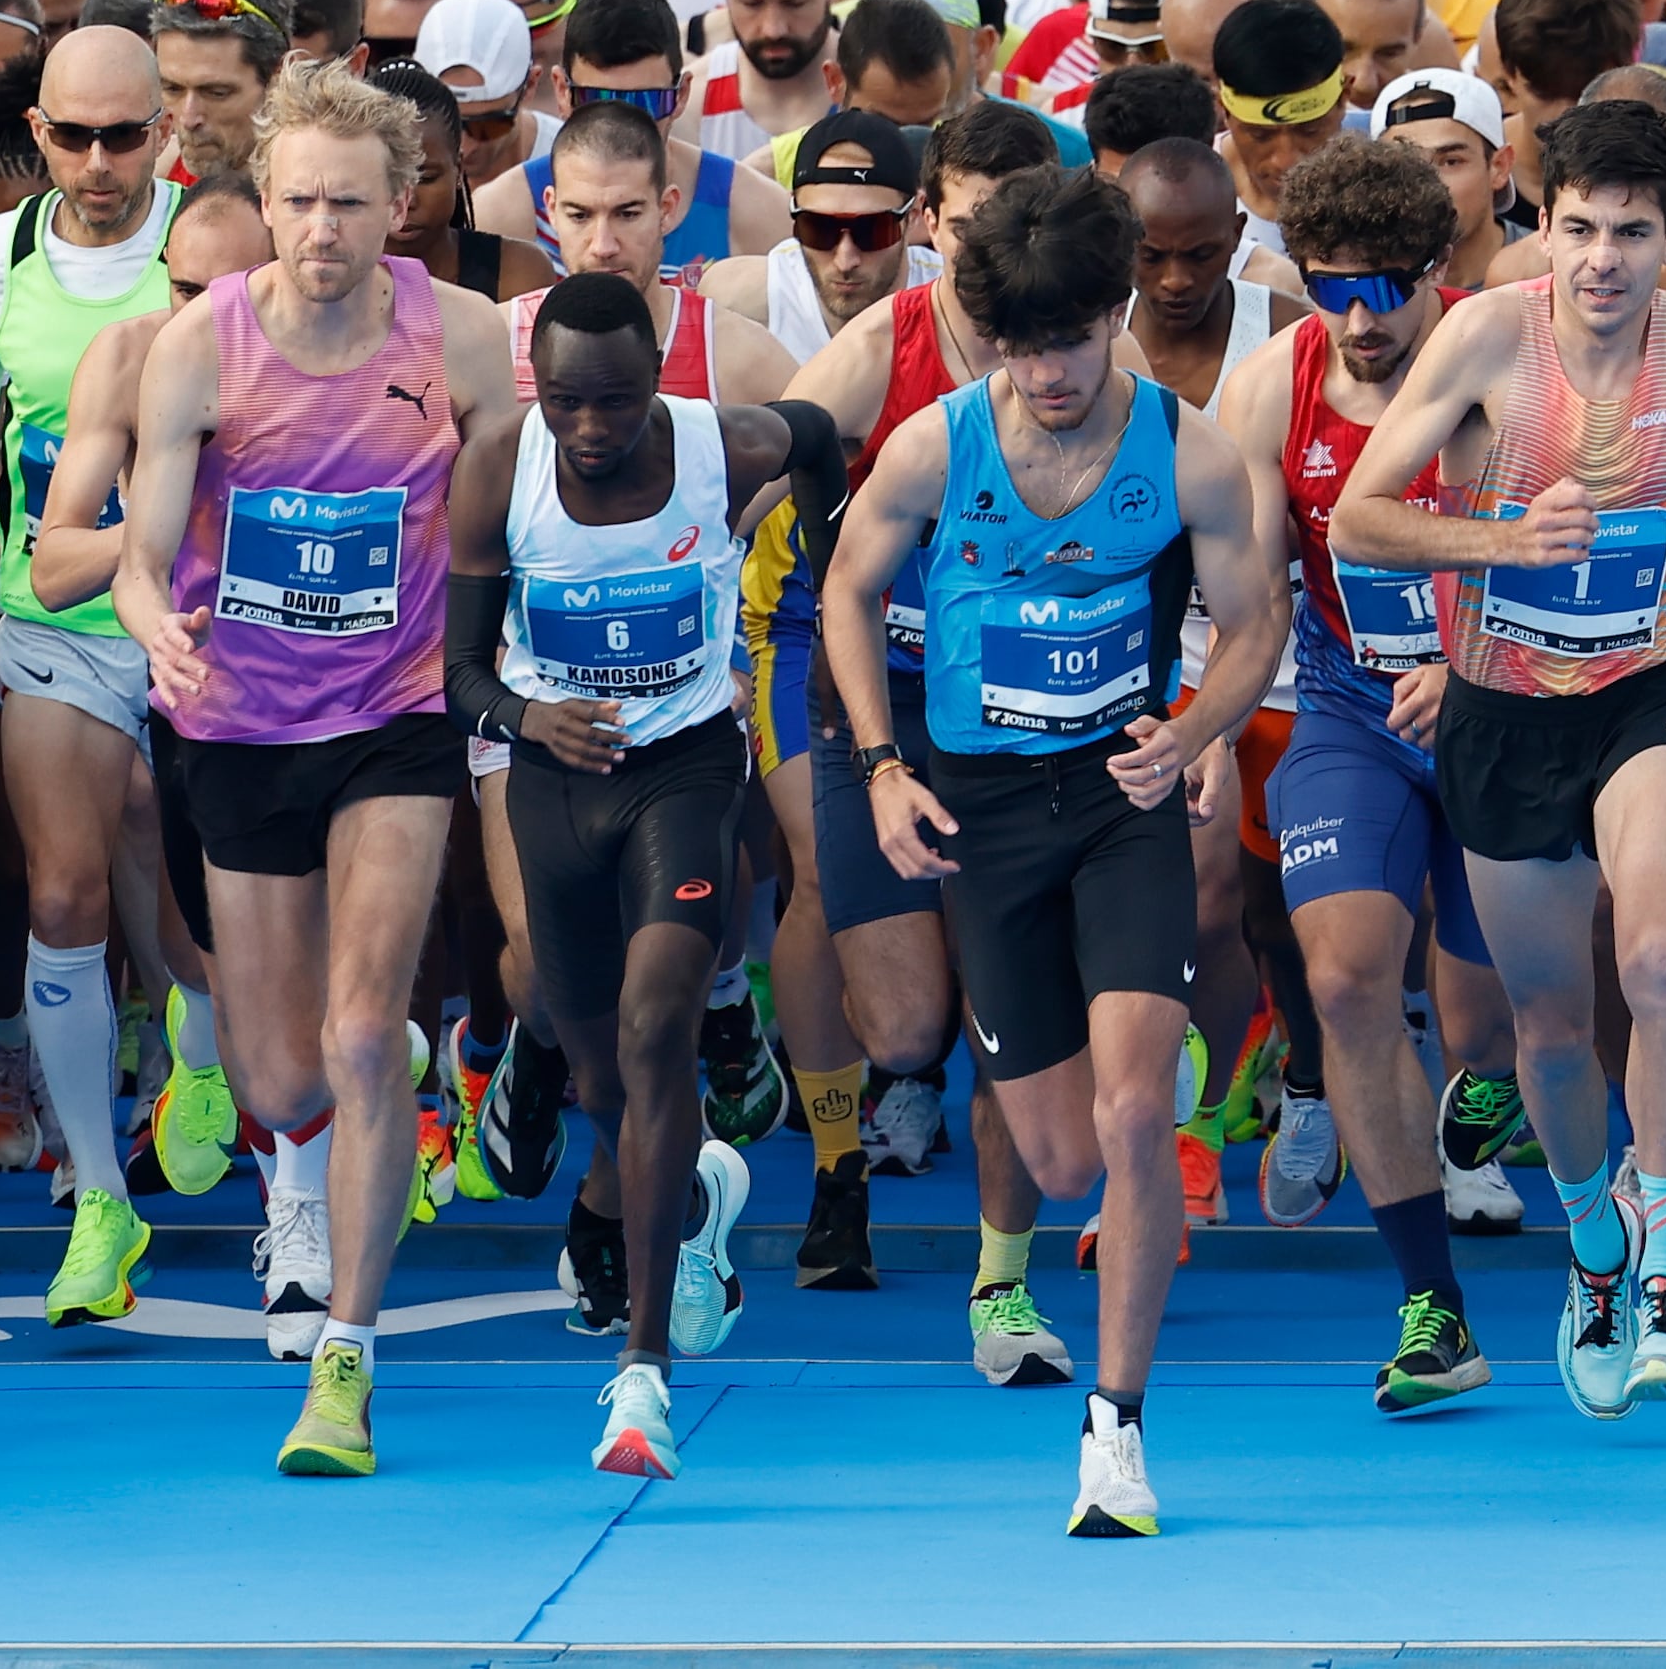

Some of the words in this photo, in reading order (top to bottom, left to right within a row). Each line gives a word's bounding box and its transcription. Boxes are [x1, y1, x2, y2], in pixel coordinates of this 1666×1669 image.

[315, 504, 370, 520] Movistar
[959, 510, 1008, 525] VIATOR
[1592, 522, 1639, 539] ovistar
[296, 540, 335, 575] 10
[609, 582, 673, 598] Movistar
[1571, 561, 1592, 599] 1
[239, 603, 284, 623] Joma
[284, 590, 341, 614] DAVID
[1068, 595, 1126, 622] Movistar
[343, 616, 386, 630] MADRID
[1504, 623, 1547, 645] Joma
[606, 620, 630, 651] 6
[1606, 635, 1646, 649] MADRID
[1047, 646, 1099, 675] 101
[1377, 656, 1418, 668] Joma
[567, 661, 678, 684] KAMOSONG
[1107, 695, 1147, 718] MADRID
[1001, 710, 1049, 730] Joma
[1281, 837, 1339, 875] ADM
